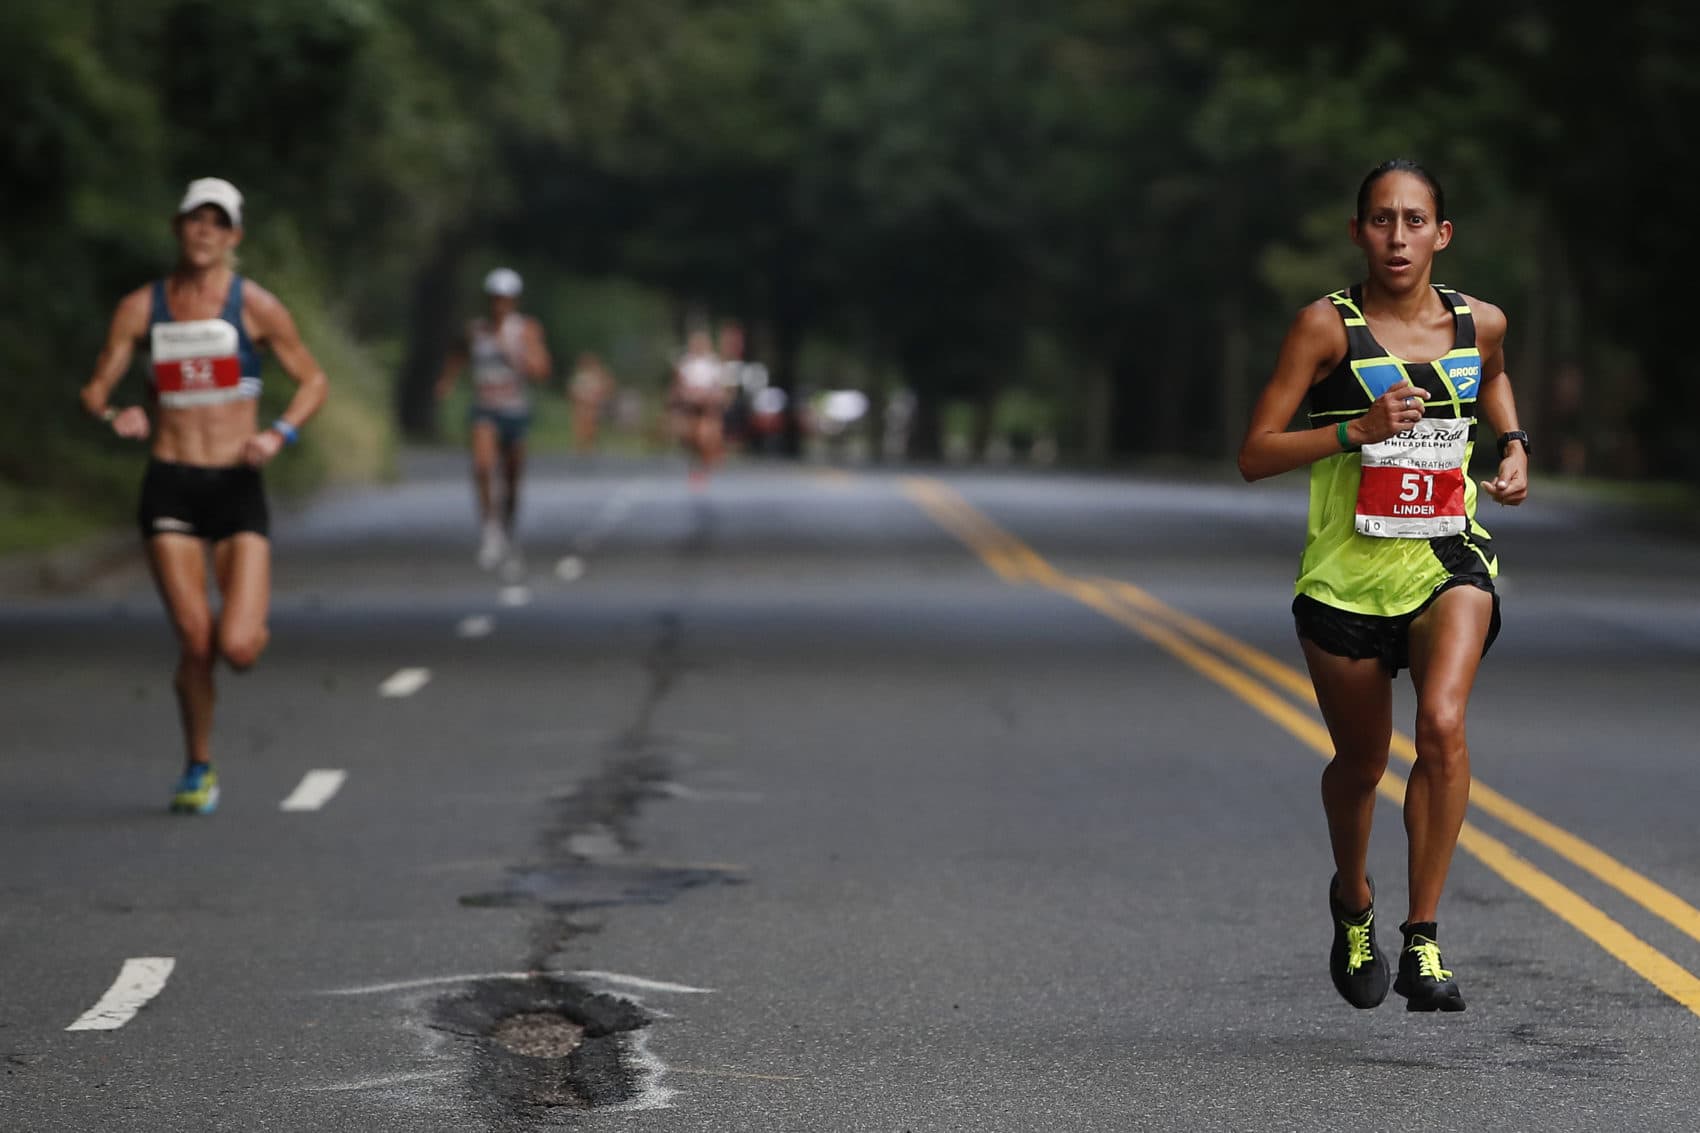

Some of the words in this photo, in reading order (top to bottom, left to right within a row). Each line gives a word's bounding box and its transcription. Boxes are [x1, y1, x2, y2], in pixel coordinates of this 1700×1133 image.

[1434, 428, 1463, 441] Roll
[1399, 473, 1434, 502] 51
[1393, 504, 1435, 515] LINDEN
